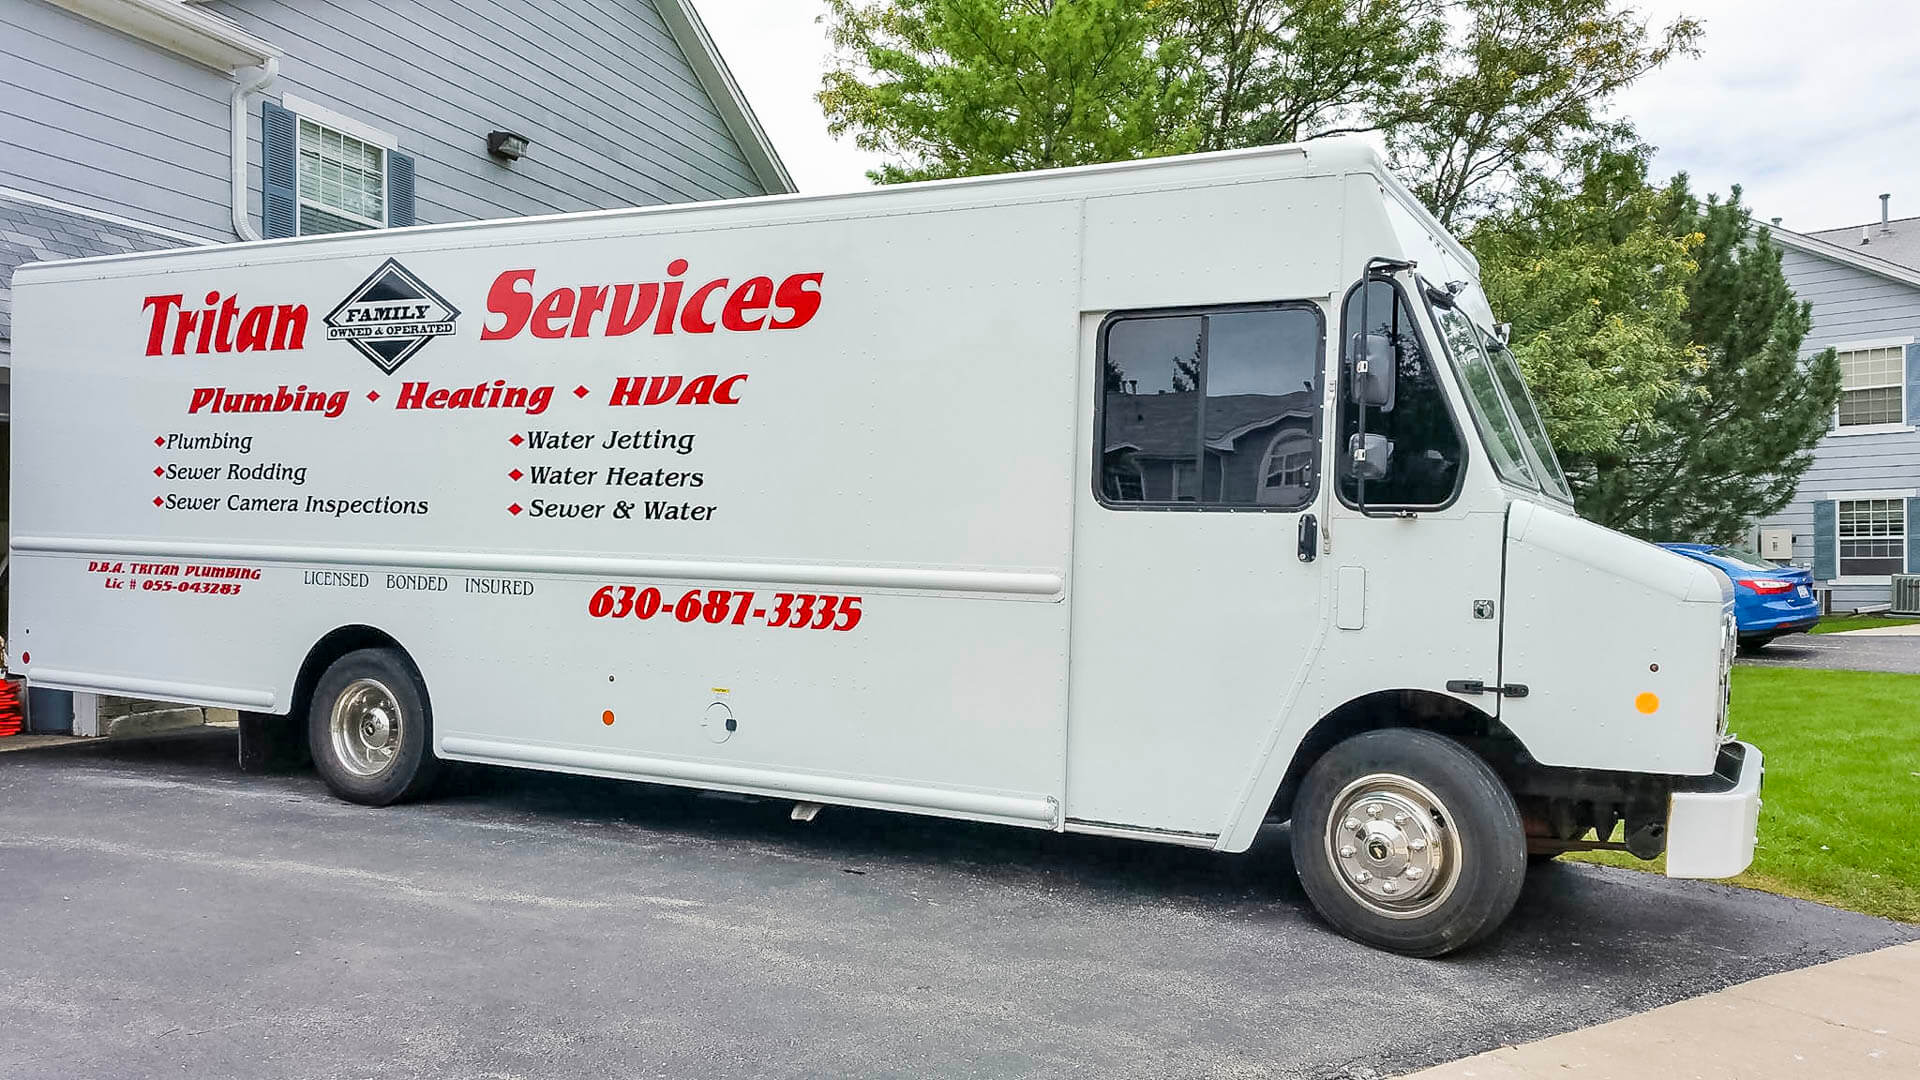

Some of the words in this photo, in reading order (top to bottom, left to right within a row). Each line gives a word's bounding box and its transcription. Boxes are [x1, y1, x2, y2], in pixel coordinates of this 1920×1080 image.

[142, 290, 309, 357] Tritan
[480, 259, 825, 341] Services
[345, 305, 431, 323] FAMILY
[330, 326, 372, 338] OWNED
[374, 326, 385, 336] &
[386, 323, 453, 335] OPERATED
[188, 385, 350, 418] Plumbing
[395, 380, 555, 414] Heating
[609, 374, 749, 406] HVAC
[166, 433, 253, 453] Plumbing
[527, 430, 595, 449] Water
[602, 429, 695, 455] Jetting
[165, 464, 221, 480] Sewer
[227, 463, 307, 485] Rodding
[530, 466, 598, 485] Water
[606, 467, 704, 487] Heaters
[165, 494, 221, 511] Sewer
[227, 495, 299, 512] Camera
[304, 495, 429, 517] Inspections
[529, 500, 606, 518] Sewer
[612, 501, 635, 519] &
[644, 501, 717, 521] Water
[87, 561, 126, 574] D.B.A.
[129, 563, 180, 576] TRITAN
[184, 565, 262, 580] PLUMBING
[105, 577, 124, 590] Lic
[129, 579, 137, 590] #
[142, 579, 242, 595] 055-043283
[303, 570, 369, 588] LICENSED
[386, 574, 448, 591] BONDED
[465, 577, 535, 596] INSURED
[588, 585, 864, 632] 630-687-3335
